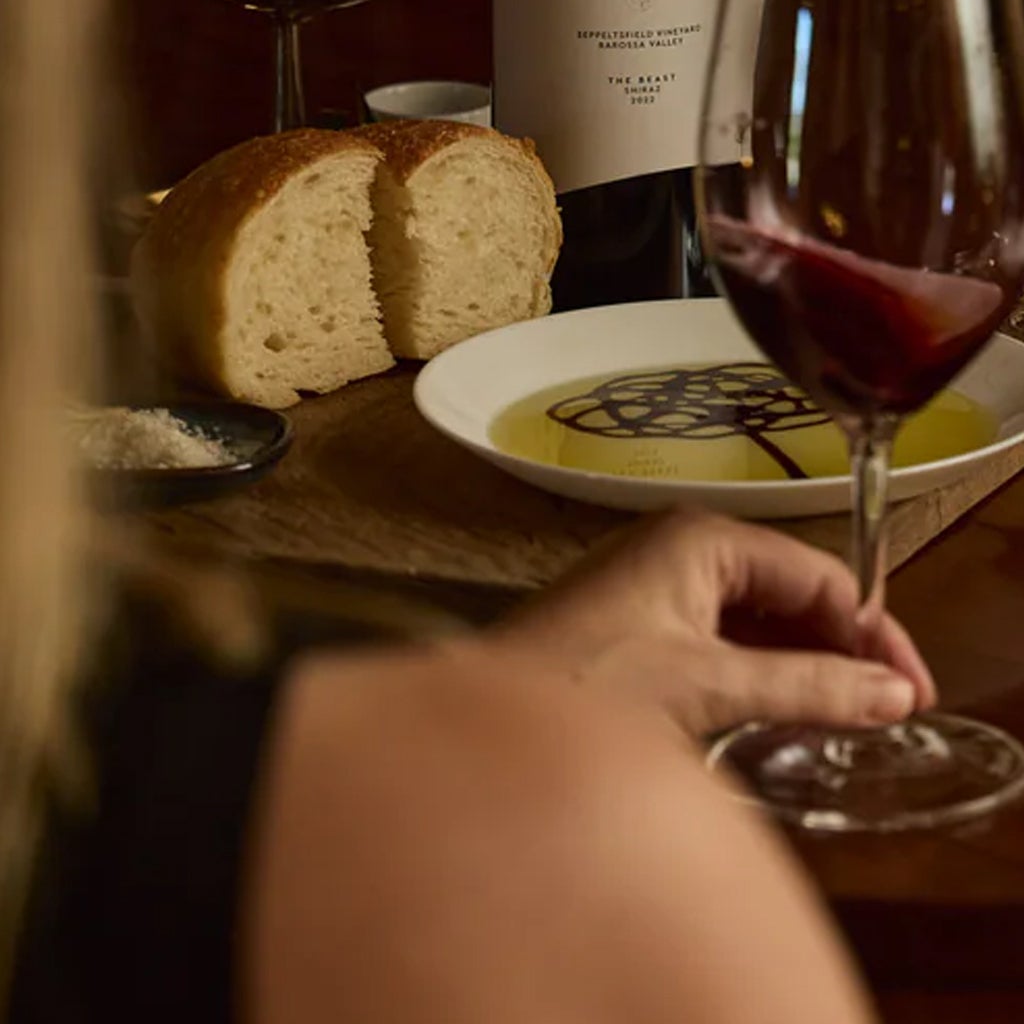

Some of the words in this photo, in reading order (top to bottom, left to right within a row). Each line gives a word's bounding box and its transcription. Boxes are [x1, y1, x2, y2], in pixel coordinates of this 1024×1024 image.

[577, 30, 654, 40] SEPPELTSFIELD
[657, 24, 701, 36] VINEYARD
[598, 41, 646, 49] BAROSSA
[649, 37, 683, 48] VALLEY
[638, 73, 676, 84] BEAST
[624, 85, 661, 94] SHIRAZ
[630, 96, 655, 105] 2022
